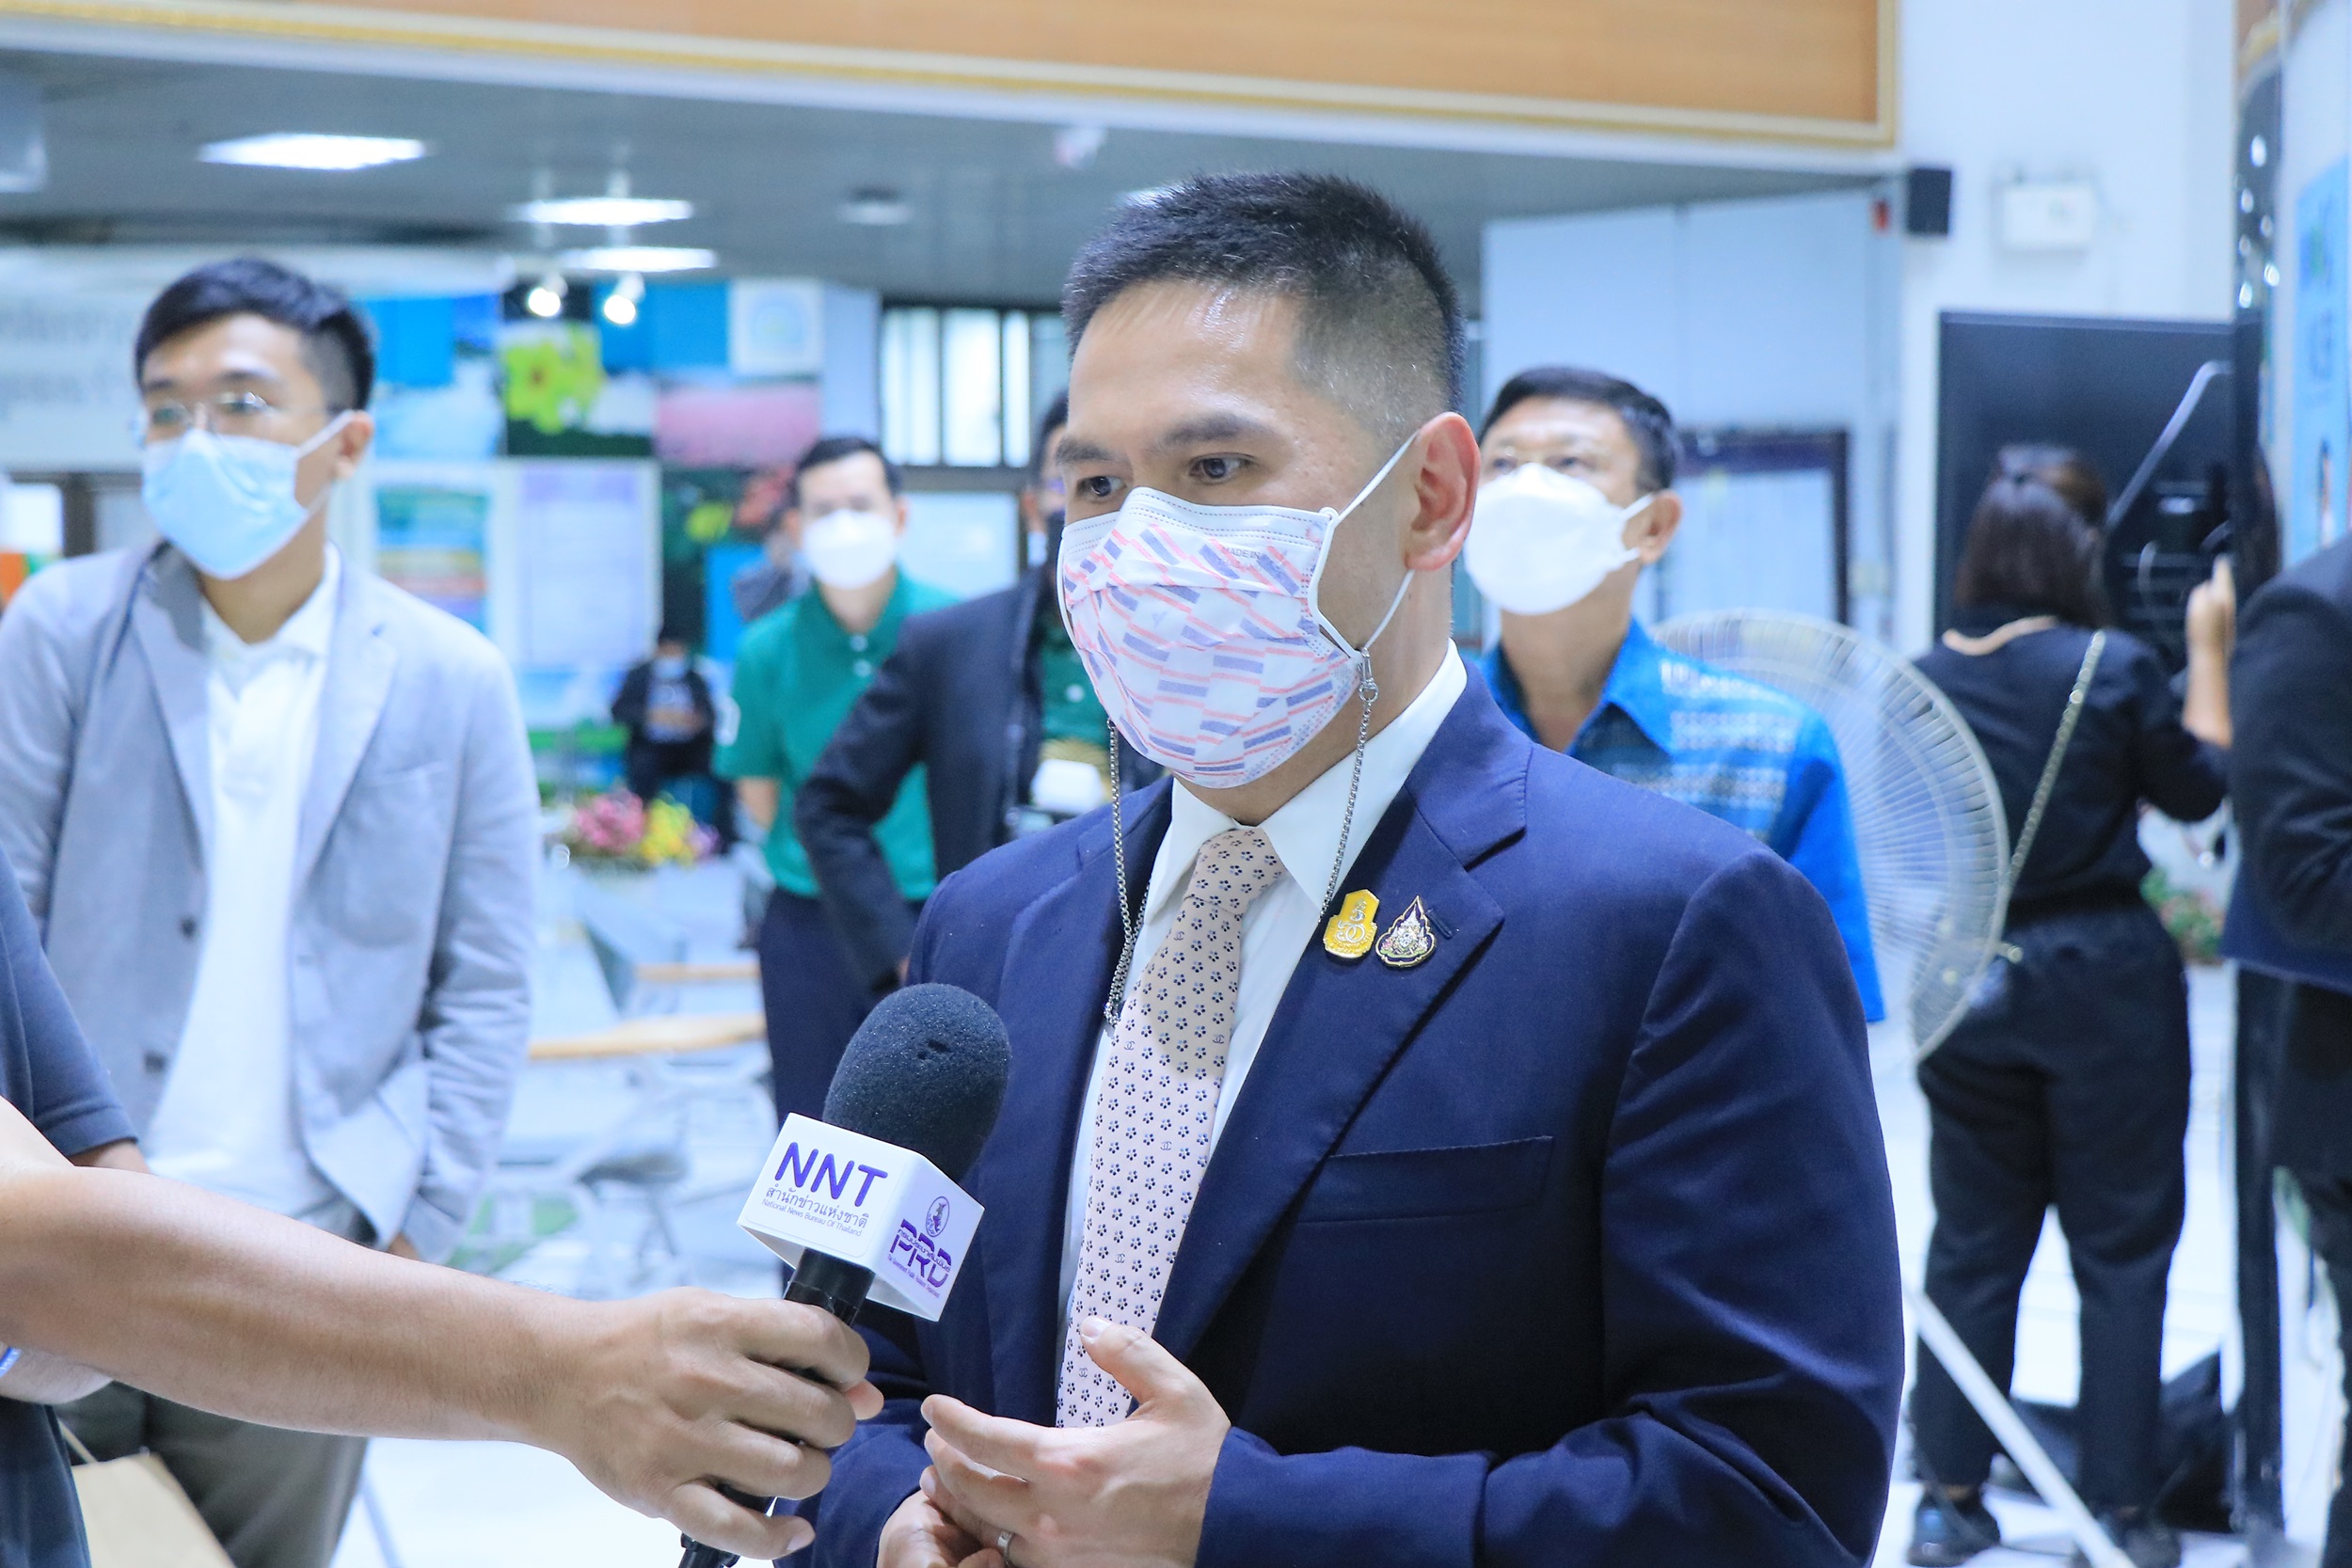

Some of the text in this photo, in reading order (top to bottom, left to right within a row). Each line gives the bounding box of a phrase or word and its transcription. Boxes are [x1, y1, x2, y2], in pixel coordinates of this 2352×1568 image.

[774, 1142, 888, 1207] NNT
[762, 1198, 863, 1237] National News Bureau Of Thailand
[766, 1183, 869, 1228] สำนักข่าวแห่งชาติ
[889, 1218, 951, 1288] PRD
